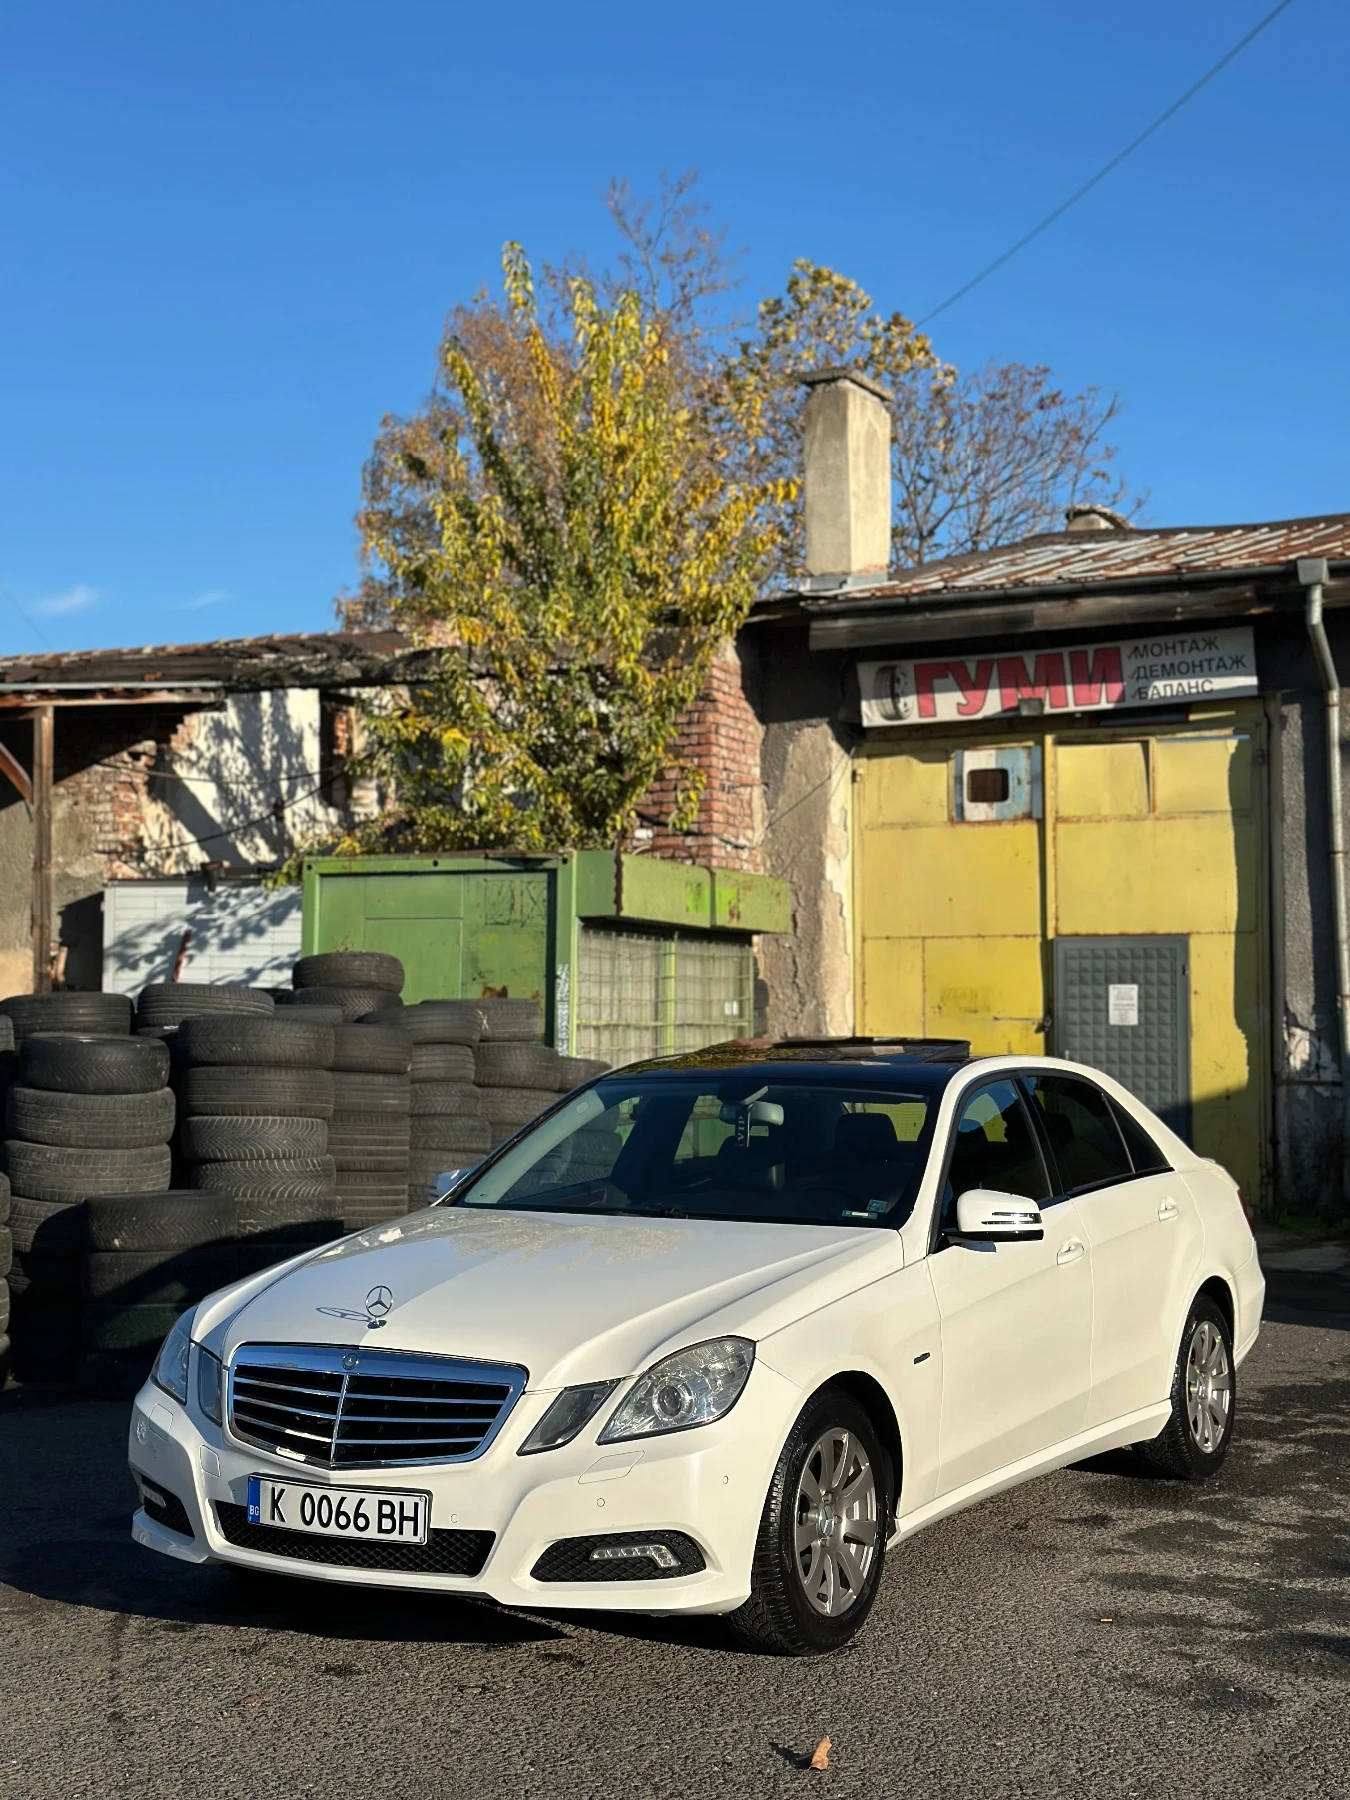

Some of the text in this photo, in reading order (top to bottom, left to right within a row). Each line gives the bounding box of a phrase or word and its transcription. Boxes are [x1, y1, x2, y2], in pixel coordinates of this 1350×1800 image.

[1133, 636, 1220, 659] МОНТАЖ
[1135, 655, 1247, 681] ДЕМОНТАЖ
[914, 646, 1126, 718] ГУМИ
[1138, 679, 1214, 700] БАЛАНС
[249, 1504, 260, 1516] BG
[270, 1486, 419, 1537] K 0066 BH
